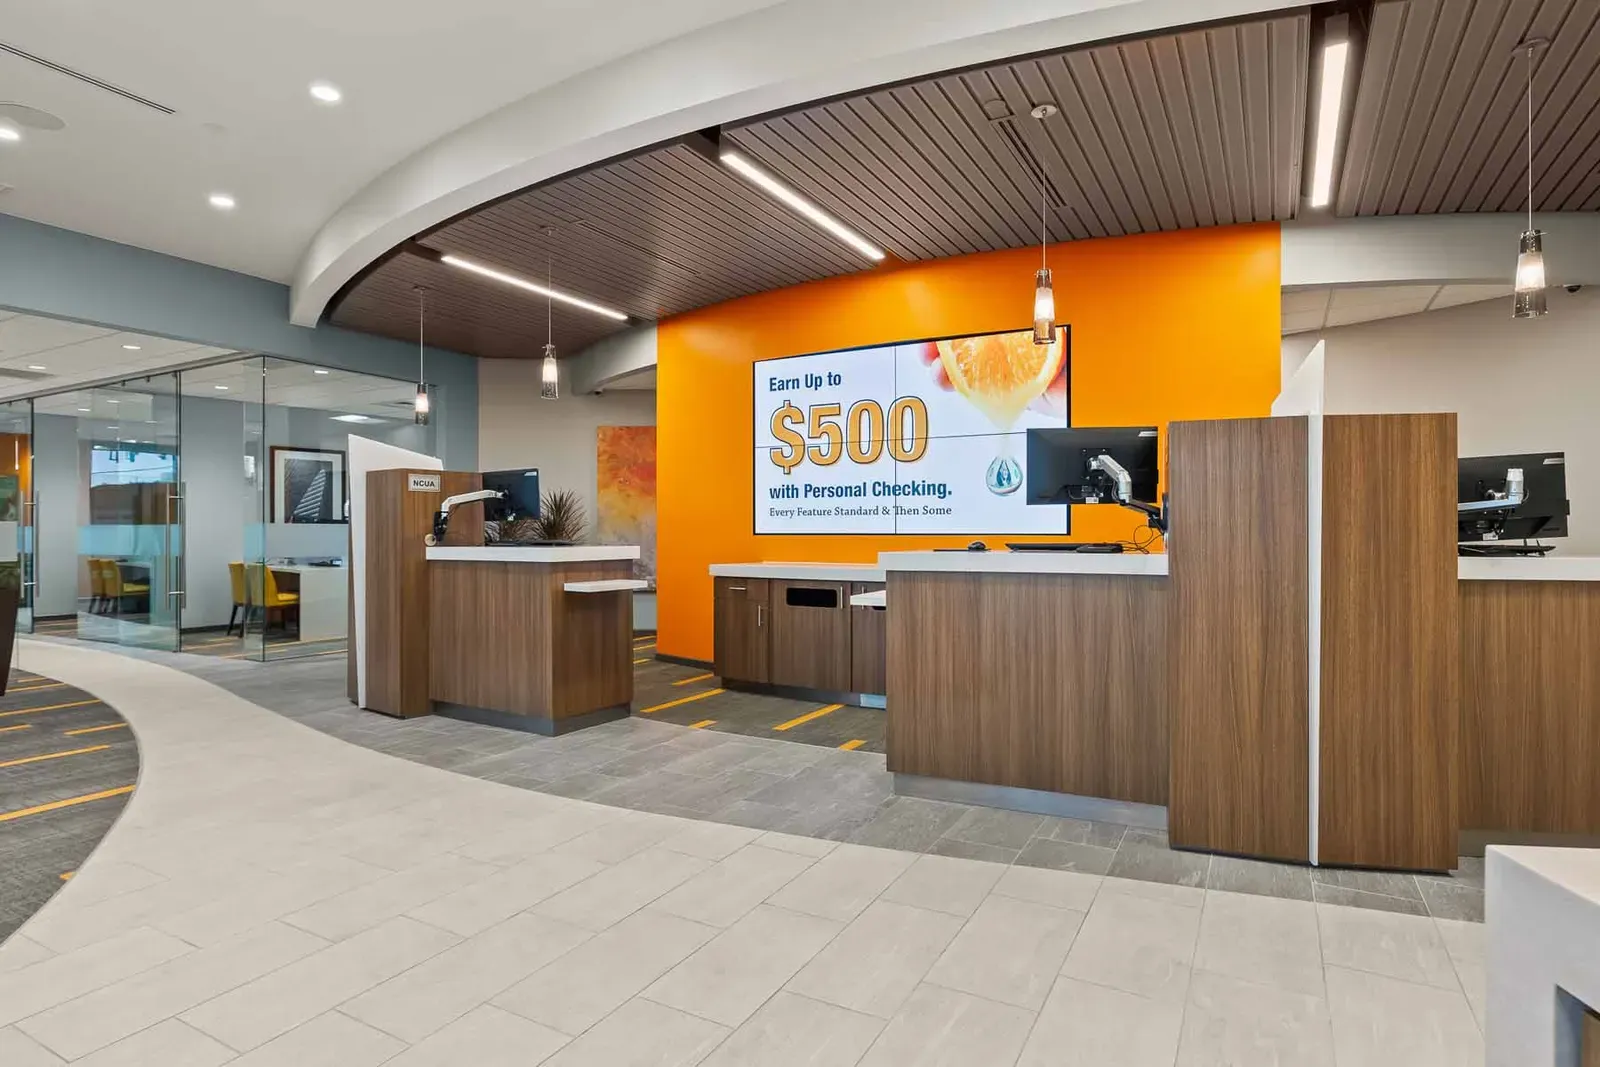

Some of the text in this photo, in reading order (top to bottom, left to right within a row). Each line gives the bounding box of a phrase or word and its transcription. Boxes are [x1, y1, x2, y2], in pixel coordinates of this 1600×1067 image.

[769, 371, 842, 392] Earn Up to
[769, 395, 930, 475] $500
[413, 479, 435, 487] NCUA
[769, 479, 953, 500] with Personal Checking.
[769, 505, 952, 519] Every Feature Standard & Then Some
